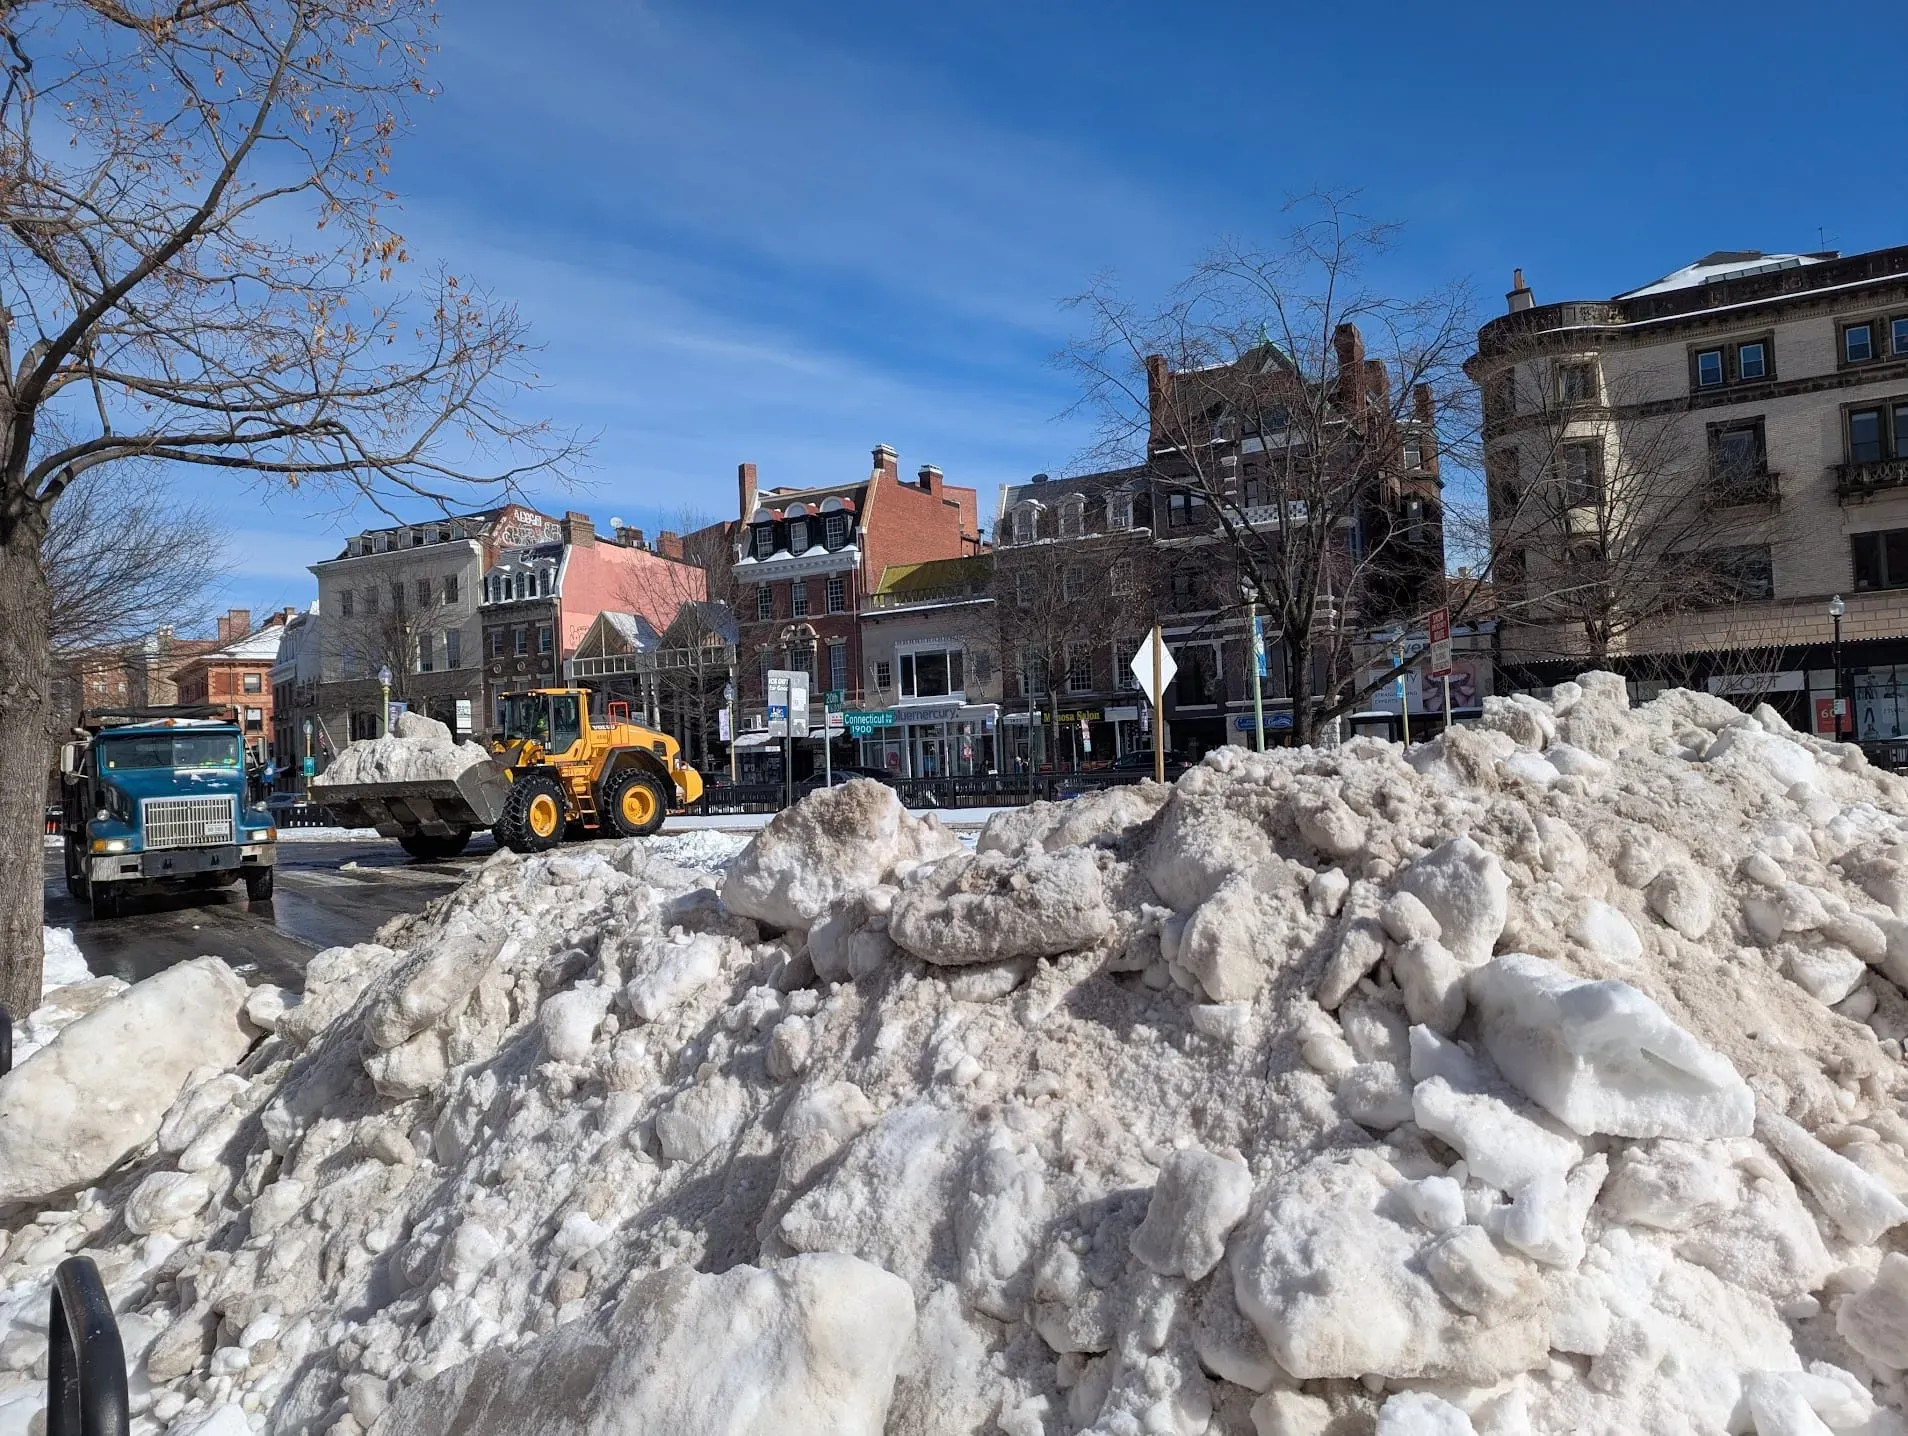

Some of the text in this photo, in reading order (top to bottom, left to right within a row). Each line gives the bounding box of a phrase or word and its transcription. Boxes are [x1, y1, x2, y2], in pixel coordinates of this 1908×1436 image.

[826, 692, 839, 704] 20th
[844, 713, 885, 725] Connecticut
[1076, 710, 1100, 721] Salon
[852, 725, 872, 733] 1900
